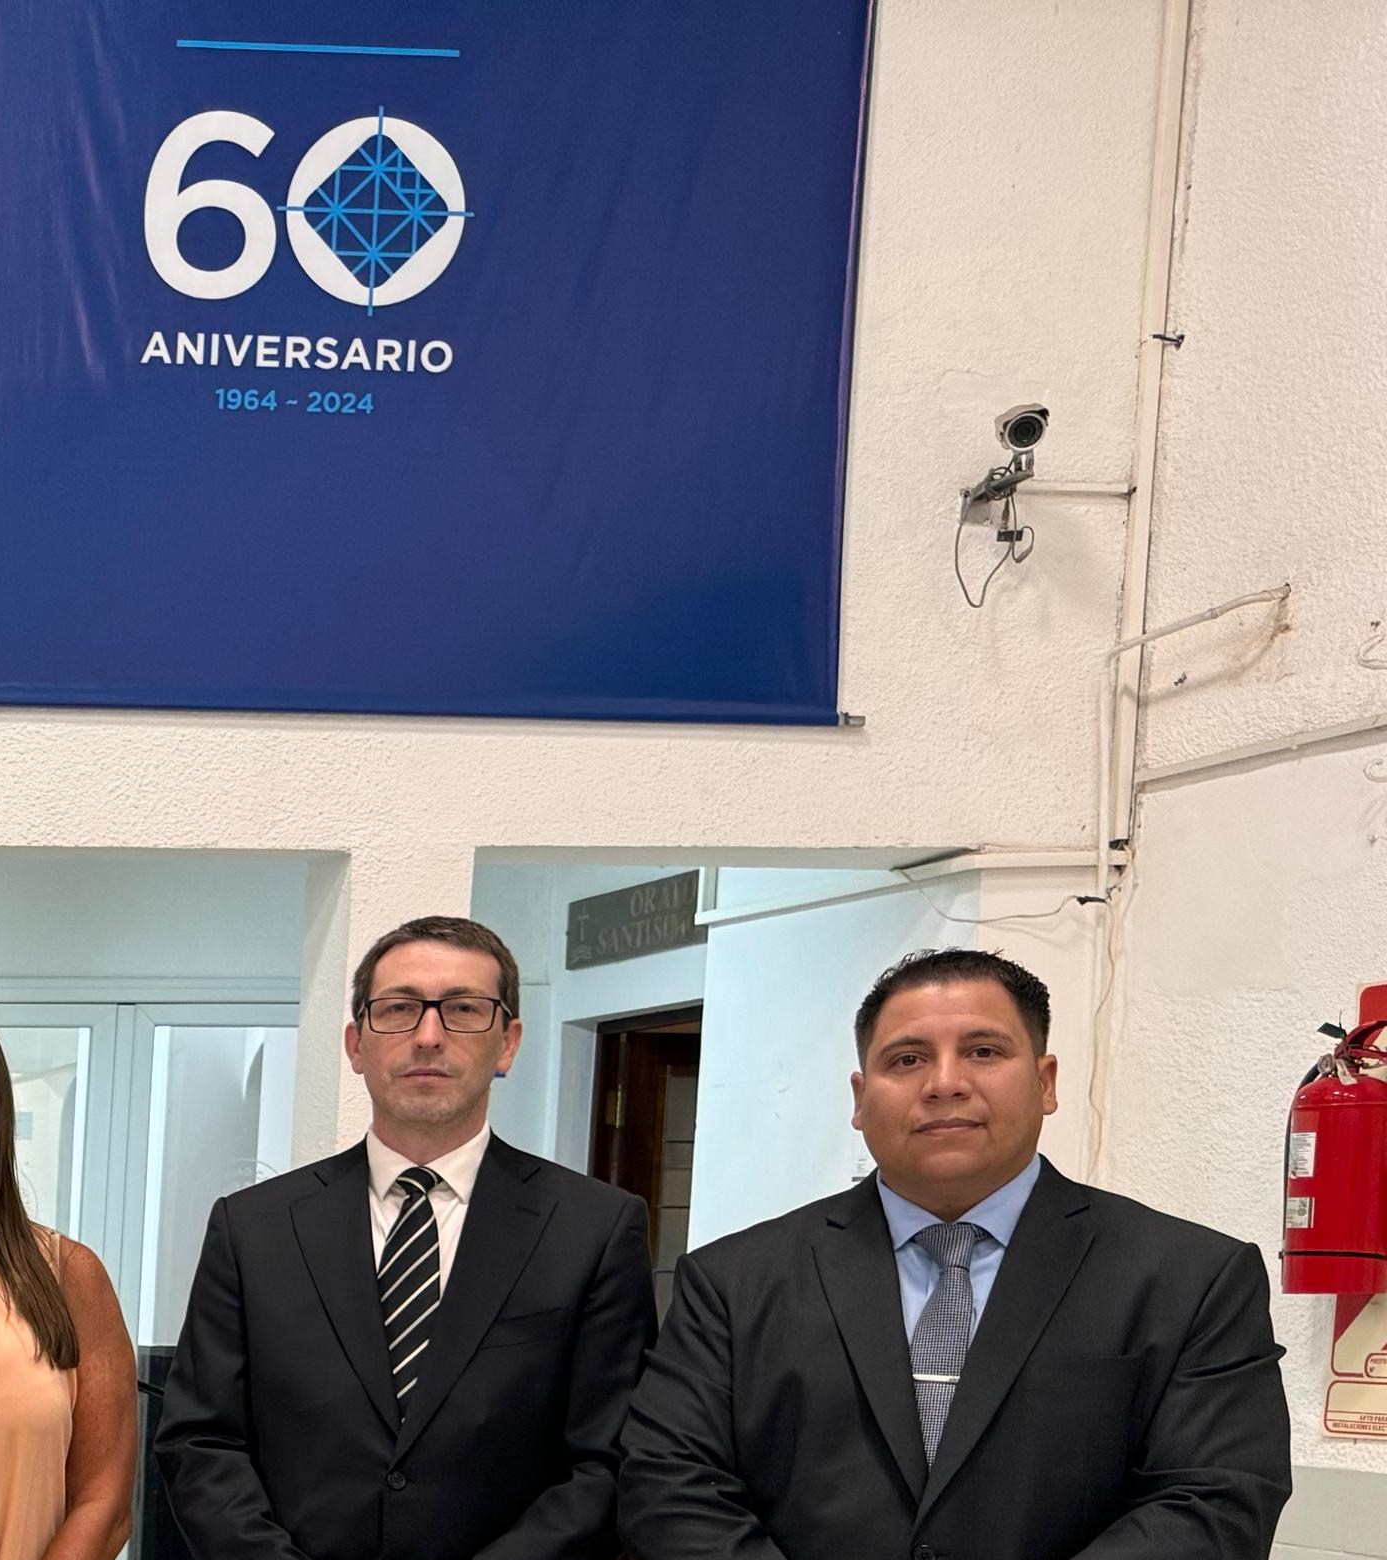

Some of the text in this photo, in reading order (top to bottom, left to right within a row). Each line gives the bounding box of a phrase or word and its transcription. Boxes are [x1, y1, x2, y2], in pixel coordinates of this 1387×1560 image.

[144, 110, 466, 307] 60
[141, 330, 454, 374] ANIVERSARIO
[215, 388, 277, 411] 1964
[306, 391, 374, 414] 2024
